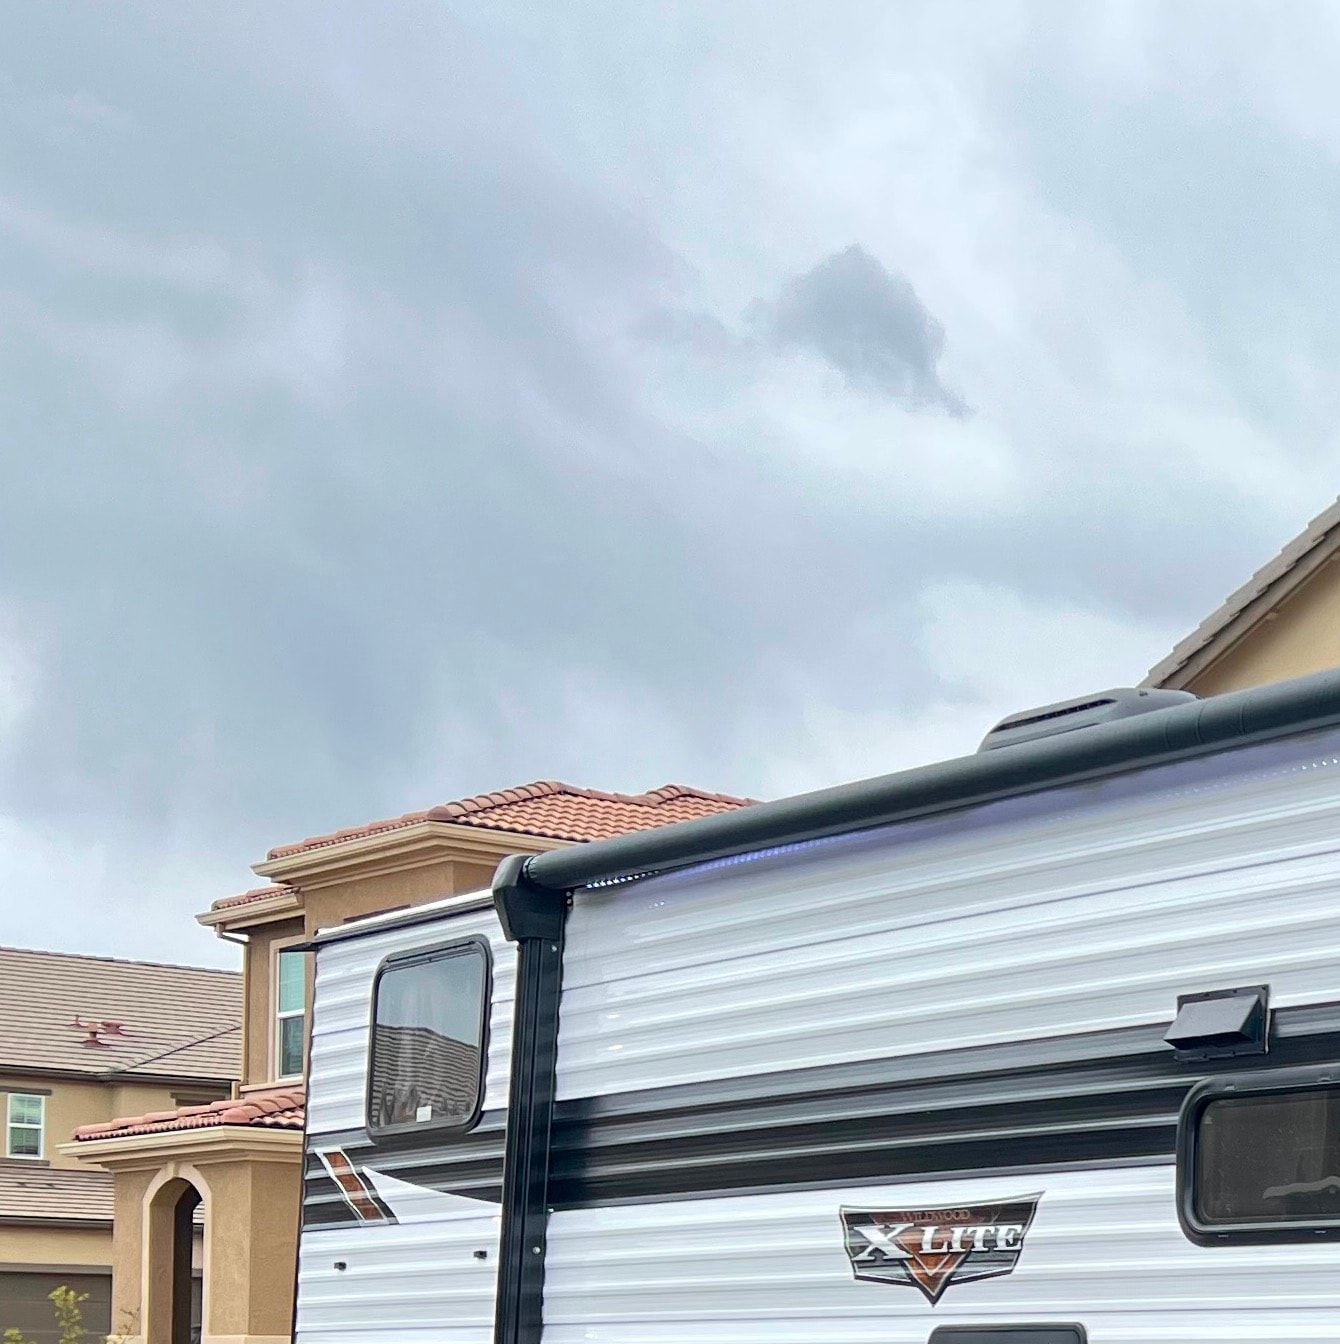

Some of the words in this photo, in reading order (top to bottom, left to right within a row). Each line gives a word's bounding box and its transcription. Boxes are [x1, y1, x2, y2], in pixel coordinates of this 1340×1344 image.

[900, 1209, 970, 1221] WILDWOOD
[851, 1222, 914, 1261] X
[919, 1224, 1022, 1253] LITE
